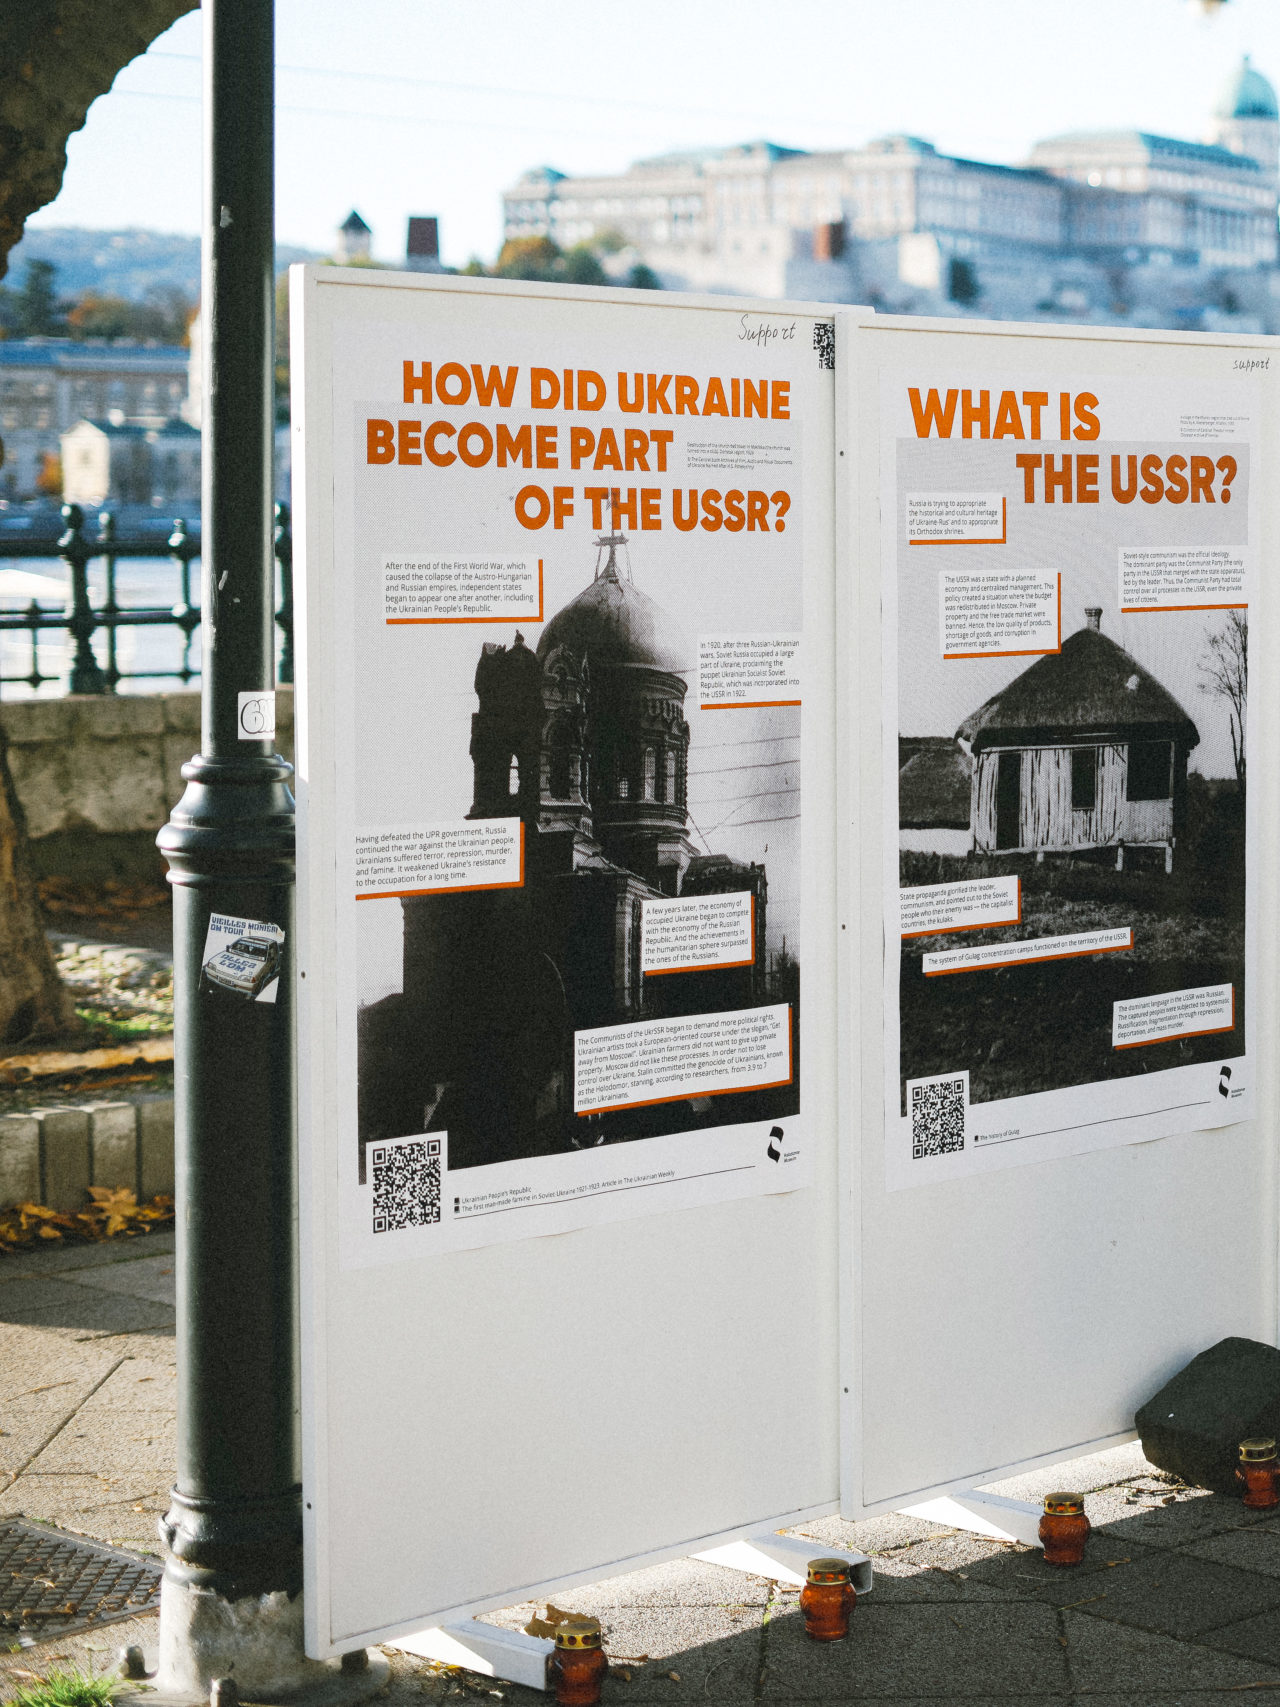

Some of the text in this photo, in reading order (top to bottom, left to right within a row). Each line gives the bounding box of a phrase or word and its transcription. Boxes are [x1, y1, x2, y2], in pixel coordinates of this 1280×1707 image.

[738, 313, 796, 346] Support
[1232, 357, 1269, 372] support
[404, 361, 790, 419] HOW DID UKRAINE
[908, 388, 1100, 441] WHAT IS
[368, 420, 673, 471] BECOME PART
[1016, 454, 1236, 504] THE USSR?
[515, 485, 790, 532] OF THE USSR?
[424, 573, 452, 582] collapse
[474, 572, 531, 582] Austro-Hungarian
[459, 583, 500, 593] independent
[386, 594, 407, 604] began
[503, 593, 533, 603] including
[433, 604, 461, 614] People's
[356, 834, 379, 845] Having
[380, 832, 410, 842] defeated
[425, 831, 440, 839] UPR
[484, 826, 506, 835] Russia
[356, 845, 389, 854] continued
[418, 841, 443, 852] against
[457, 838, 489, 848] Ukrainian
[356, 855, 391, 865] Ukrainians
[393, 853, 422, 862] suffered
[356, 867, 369, 875] and
[403, 862, 439, 872] weakened
[440, 860, 471, 869] Ukraine's
[472, 857, 506, 867] resistance
[377, 875, 415, 887] occupation
[433, 872, 449, 883] long
[938, 956, 957, 966] system
[964, 952, 980, 962] Gulag
[981, 947, 1016, 958] concentration
[1016, 947, 1032, 955] camps
[1033, 942, 1060, 952] functioned
[1077, 937, 1097, 948] territory
[462, 1186, 531, 1204] Ukrainian People's Republic
[484, 1198, 511, 1209] man-made
[512, 1195, 530, 1204] famine
[538, 1191, 555, 1200] Soviet
[556, 1188, 575, 1197] Ukraine
[601, 1181, 616, 1190] Article
[633, 1174, 657, 1184] Ukrainian
[658, 1171, 675, 1182] Weekly
